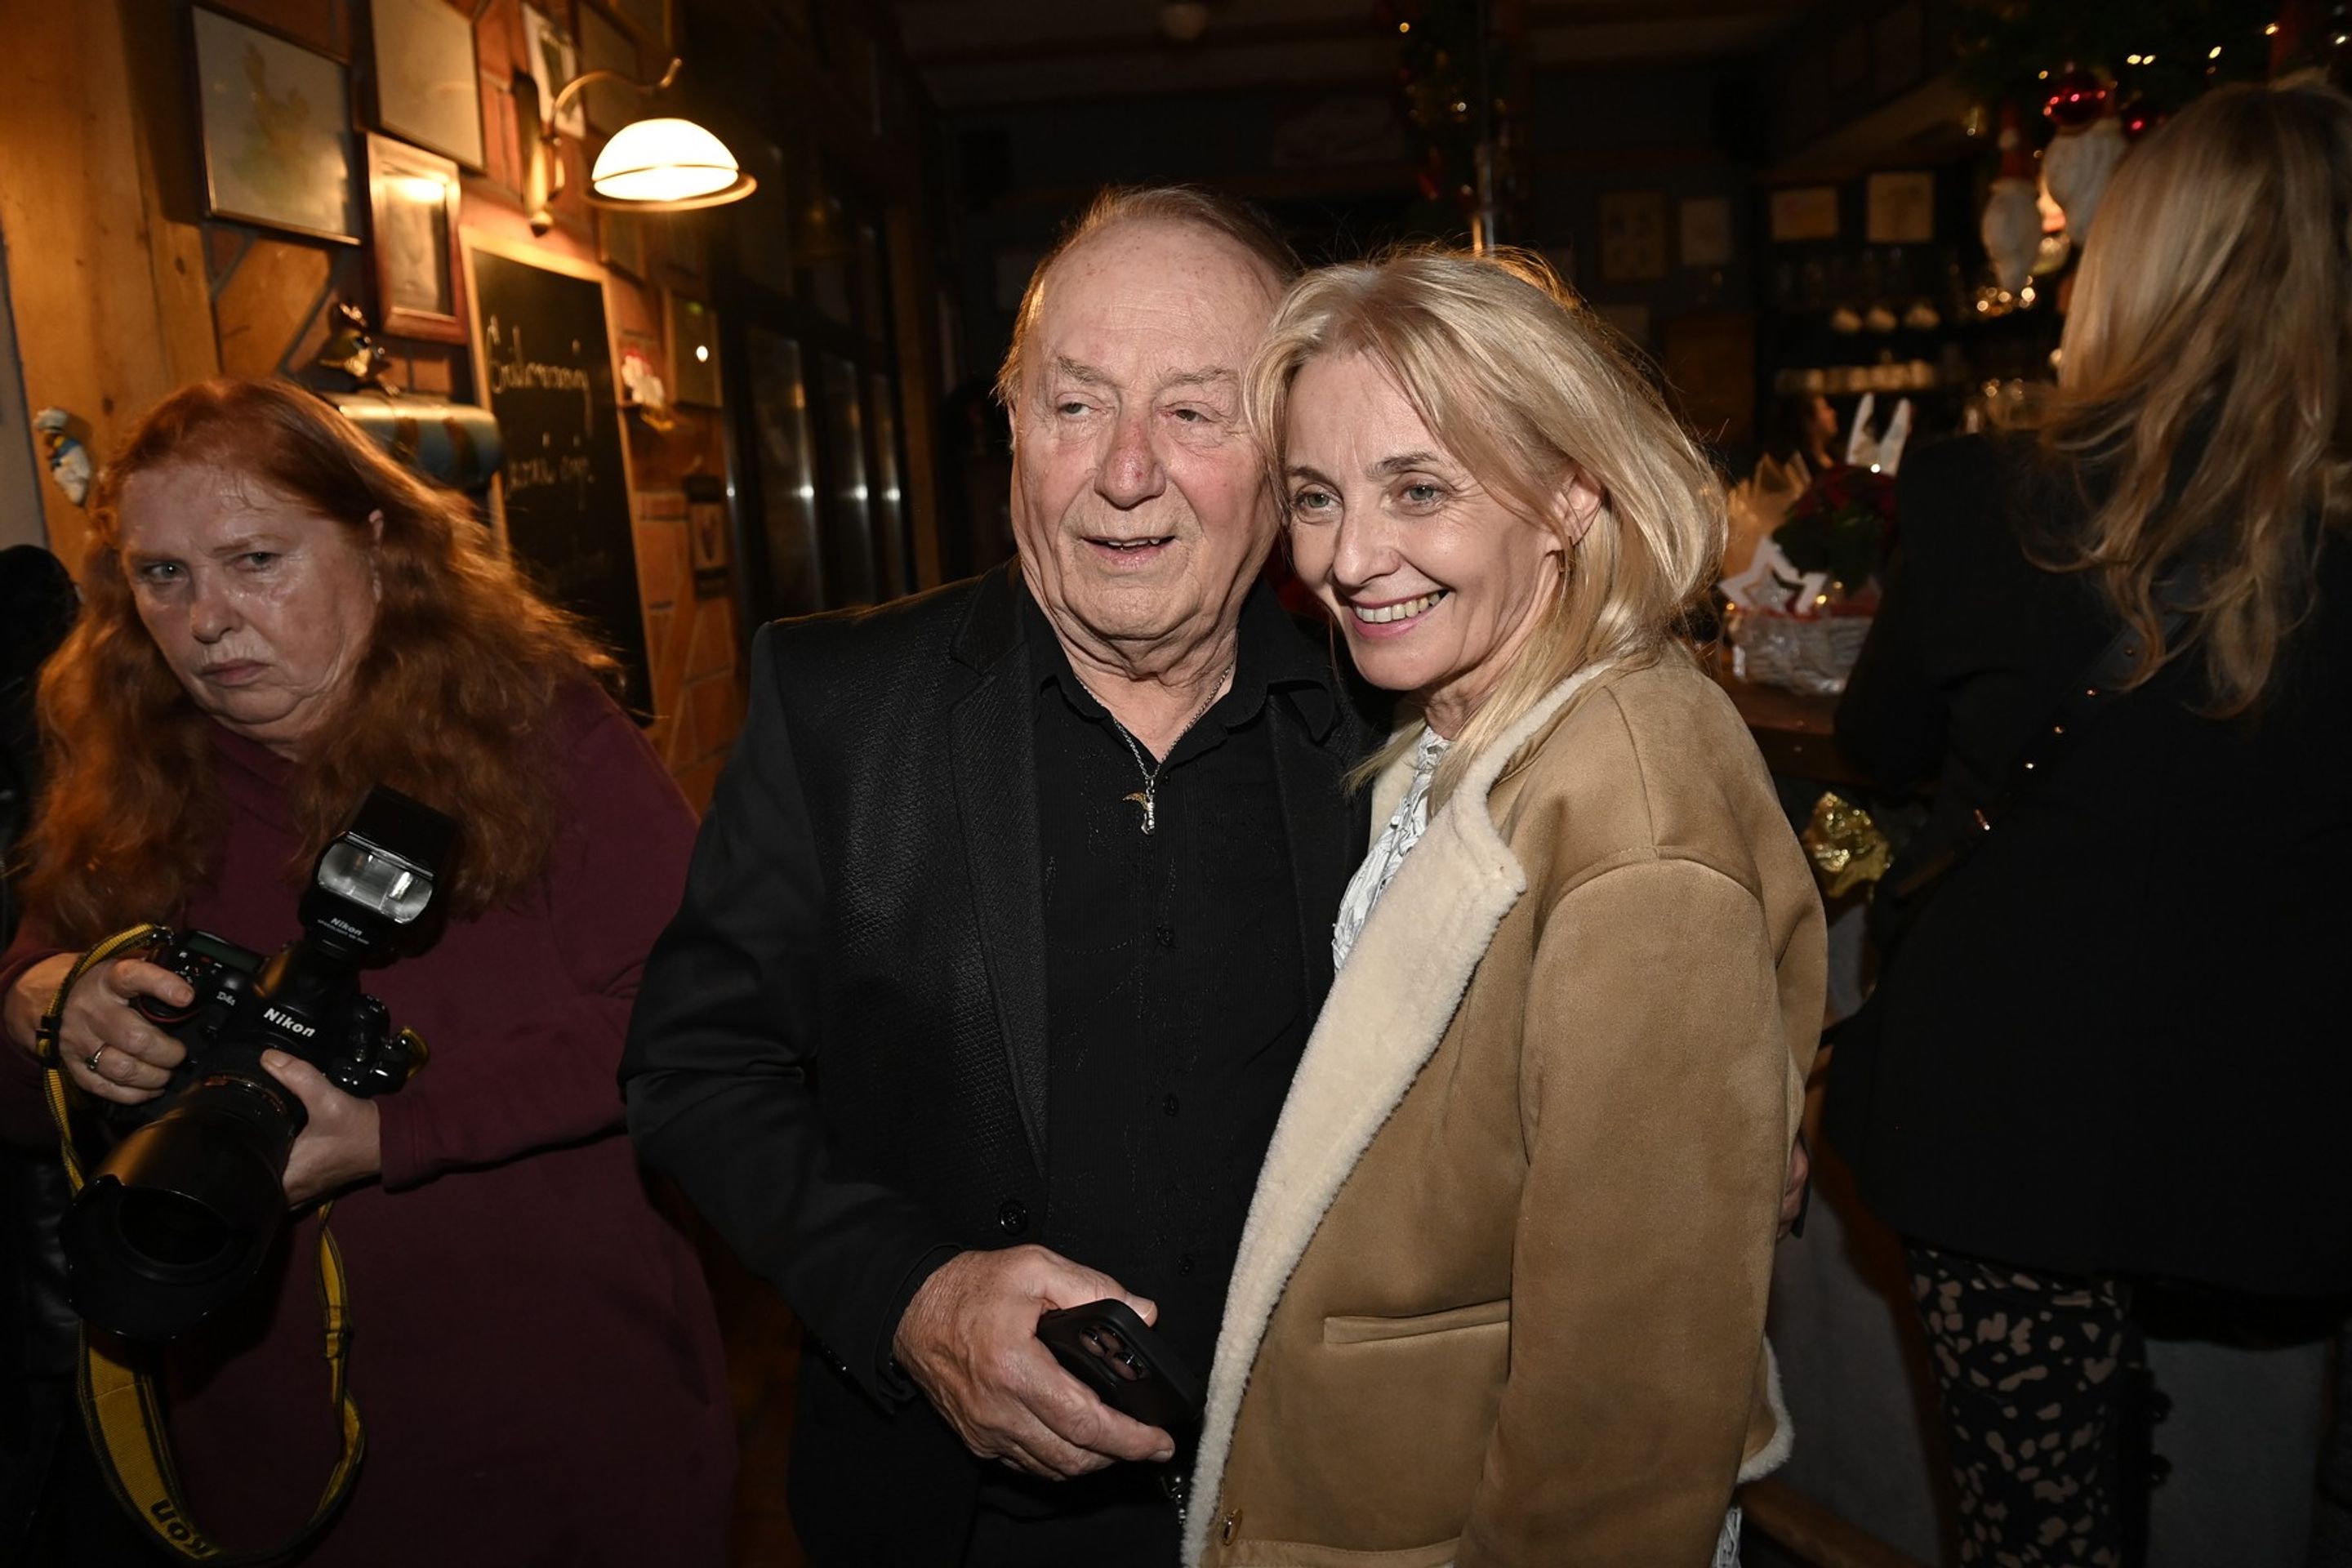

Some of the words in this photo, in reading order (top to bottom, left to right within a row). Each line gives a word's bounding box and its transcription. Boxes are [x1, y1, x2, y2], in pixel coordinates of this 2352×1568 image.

[330, 917, 363, 936] Nikon
[263, 1008, 316, 1037] Nikon
[152, 1500, 211, 1554] kon
